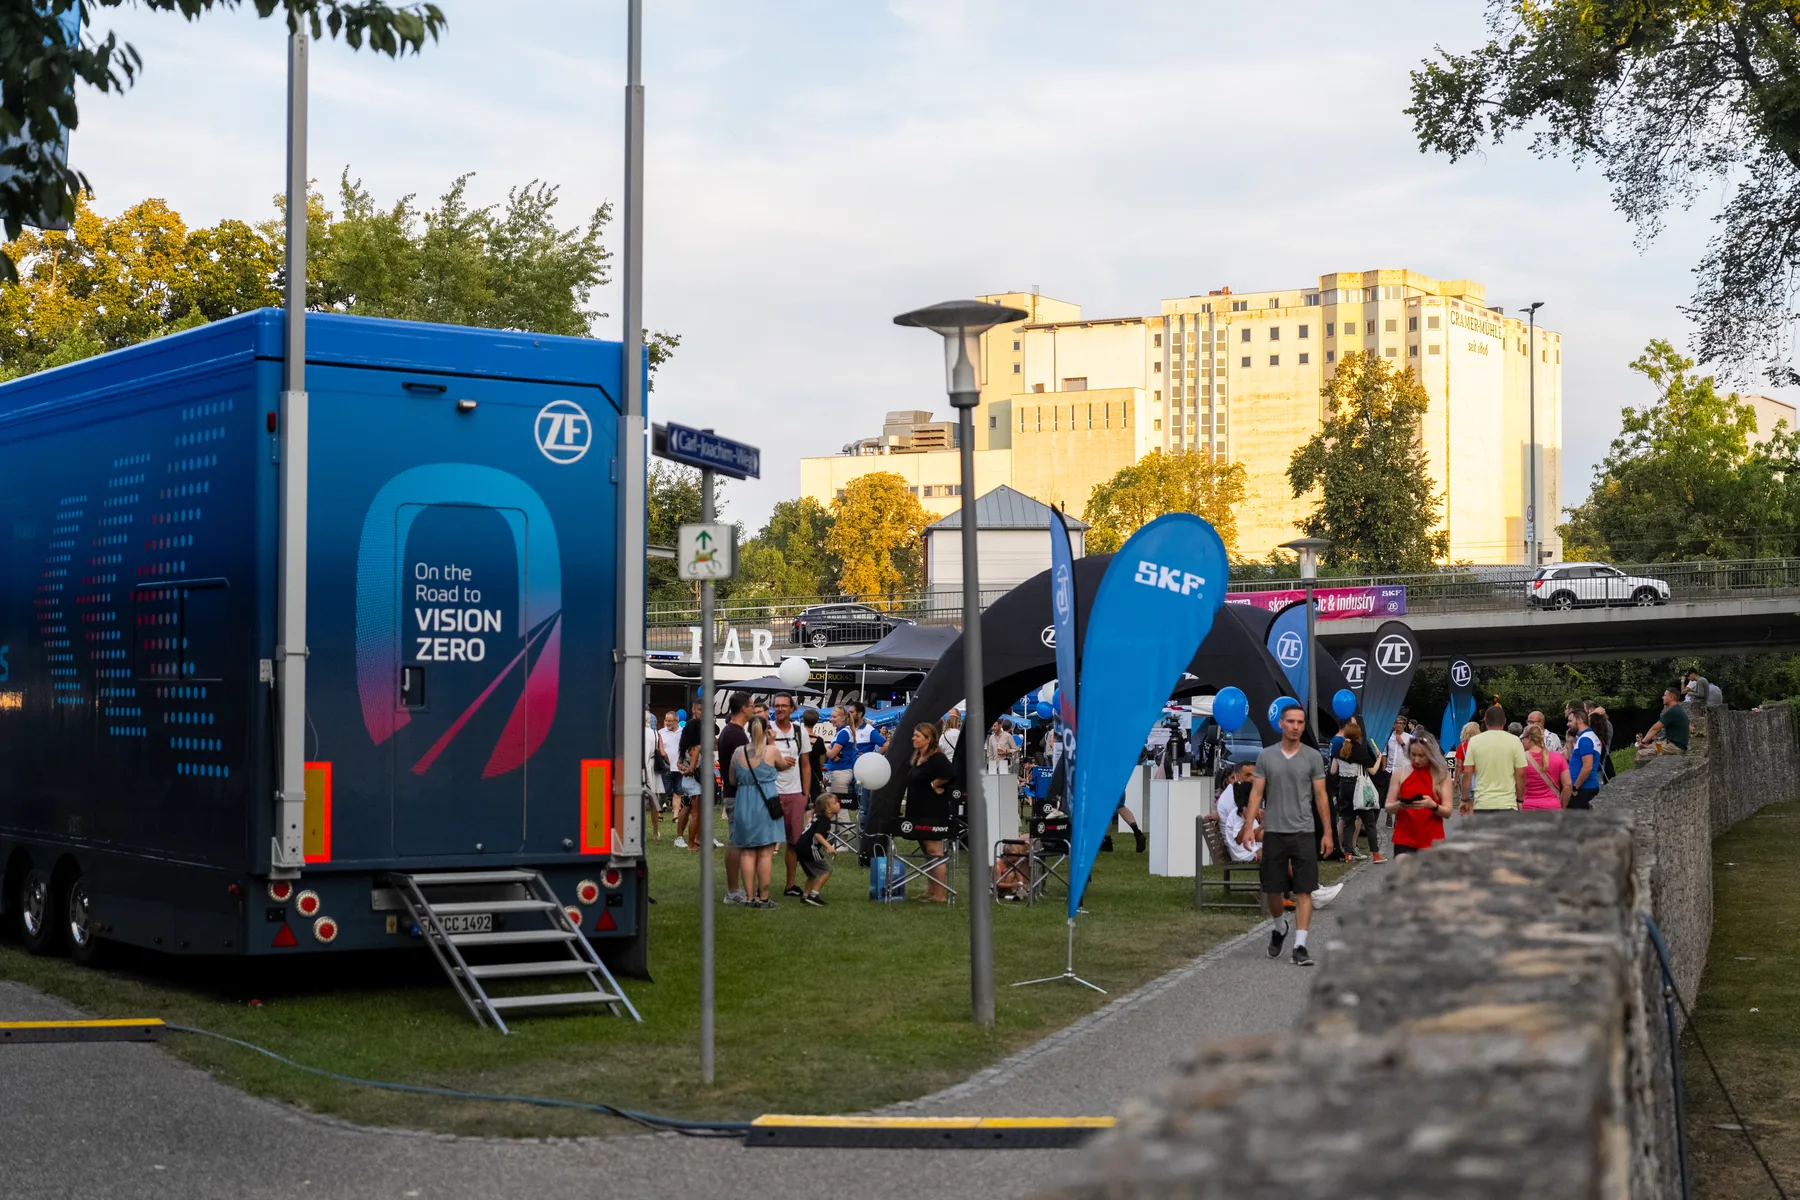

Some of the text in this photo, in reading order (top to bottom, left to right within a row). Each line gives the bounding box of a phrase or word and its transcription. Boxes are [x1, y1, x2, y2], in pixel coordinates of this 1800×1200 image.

[1451, 310, 1502, 340] CRAMER-MÜHLE
[537, 406, 590, 457] ZF
[415, 562, 473, 582] On the
[1134, 560, 1206, 596] SKF
[416, 584, 482, 603] Road to
[1327, 594, 1335, 610] &
[1336, 594, 1376, 612] industry
[1381, 589, 1403, 597] SKF
[415, 607, 502, 633] VISION
[416, 637, 486, 662] ZERO
[1278, 635, 1302, 664] ZF
[1377, 639, 1411, 671] ZF
[1342, 661, 1366, 685] ZF
[1452, 663, 1471, 684] ZF
[444, 916, 460, 931] CC
[462, 915, 491, 931] 1492
